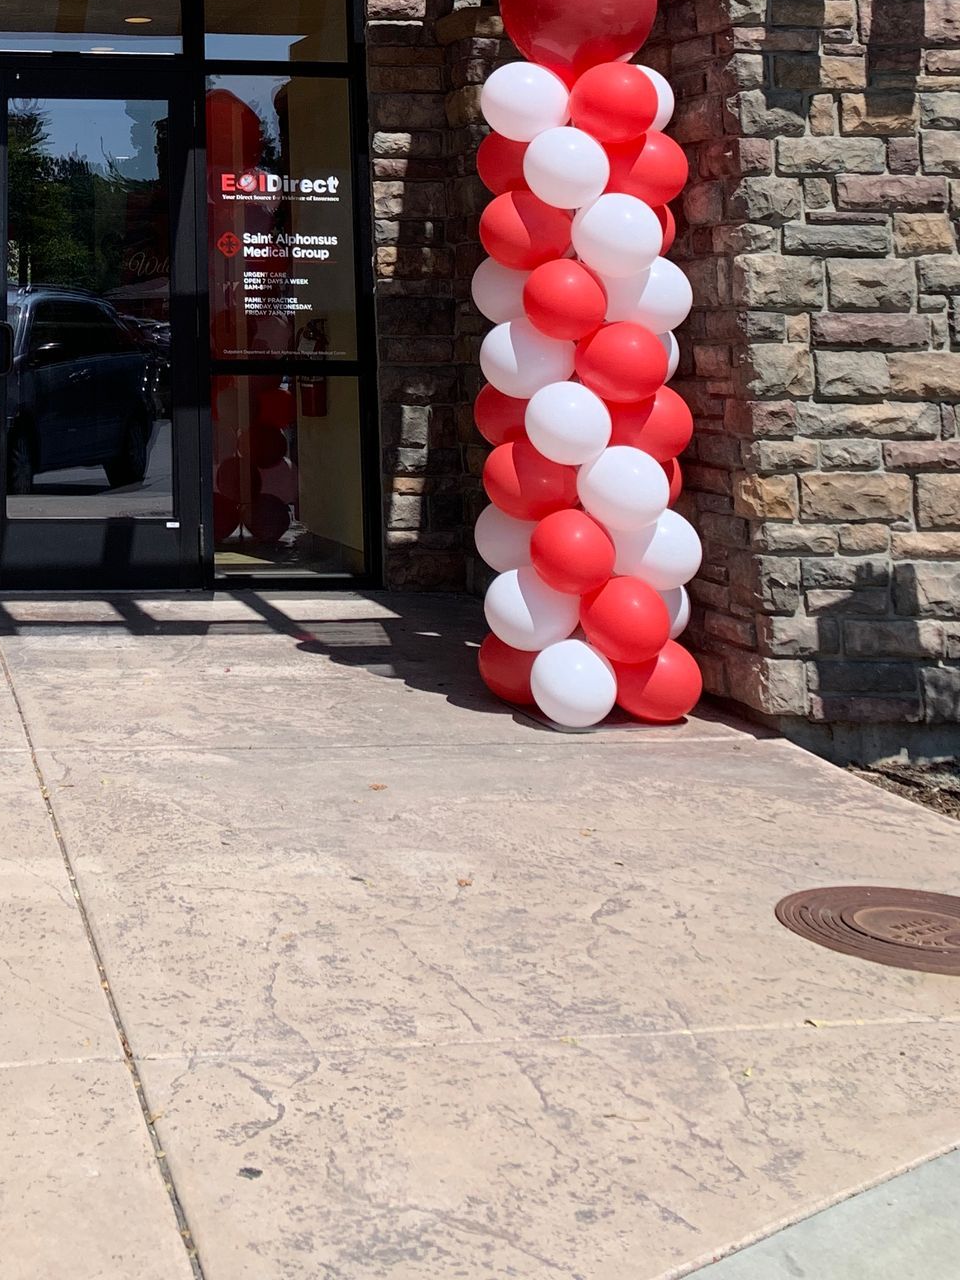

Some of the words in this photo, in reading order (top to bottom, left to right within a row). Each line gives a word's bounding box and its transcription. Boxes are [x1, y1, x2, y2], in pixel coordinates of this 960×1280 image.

[243, 232, 273, 245] Saint
[276, 233, 338, 248] Alphonsus
[243, 246, 289, 258] Medical
[292, 247, 329, 260] Group
